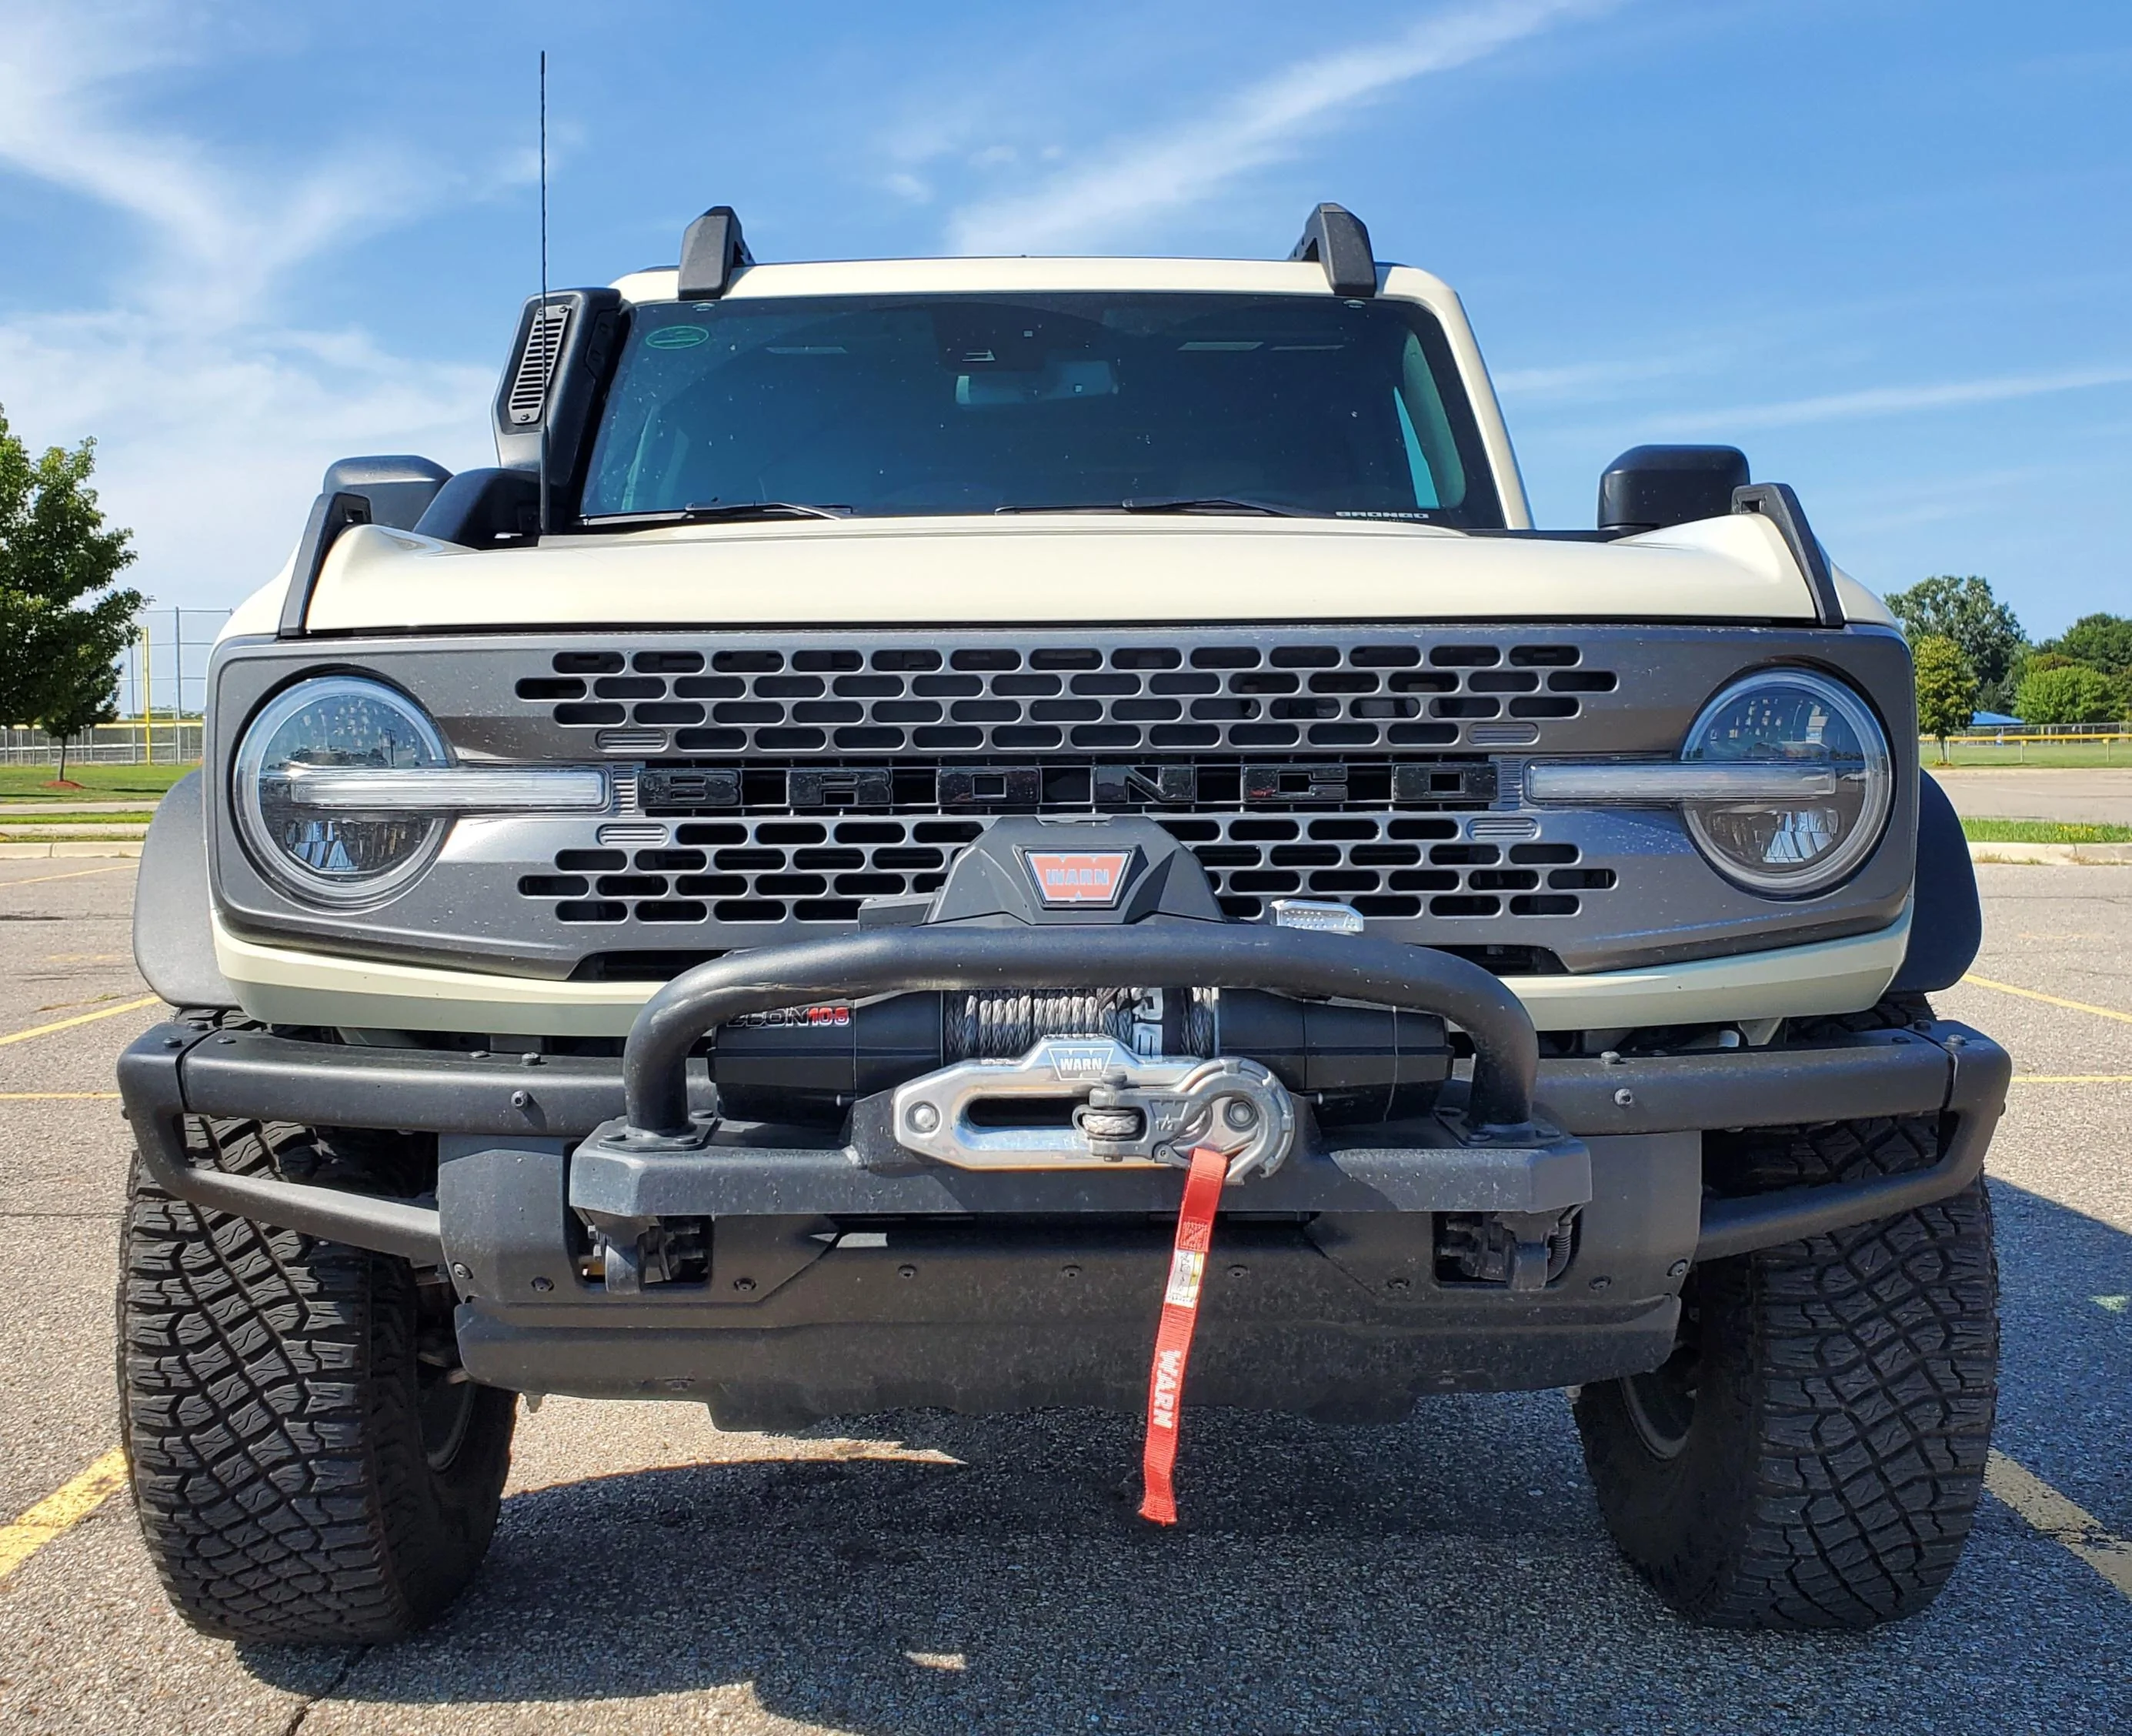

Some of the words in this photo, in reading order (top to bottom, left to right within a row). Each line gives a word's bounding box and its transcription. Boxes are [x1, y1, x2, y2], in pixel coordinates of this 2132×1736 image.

[637, 764, 1497, 807] BRONCO
[1045, 868, 1109, 886] WARN
[1059, 1057, 1103, 1071] WARN
[1153, 1350, 1181, 1428] WARN
